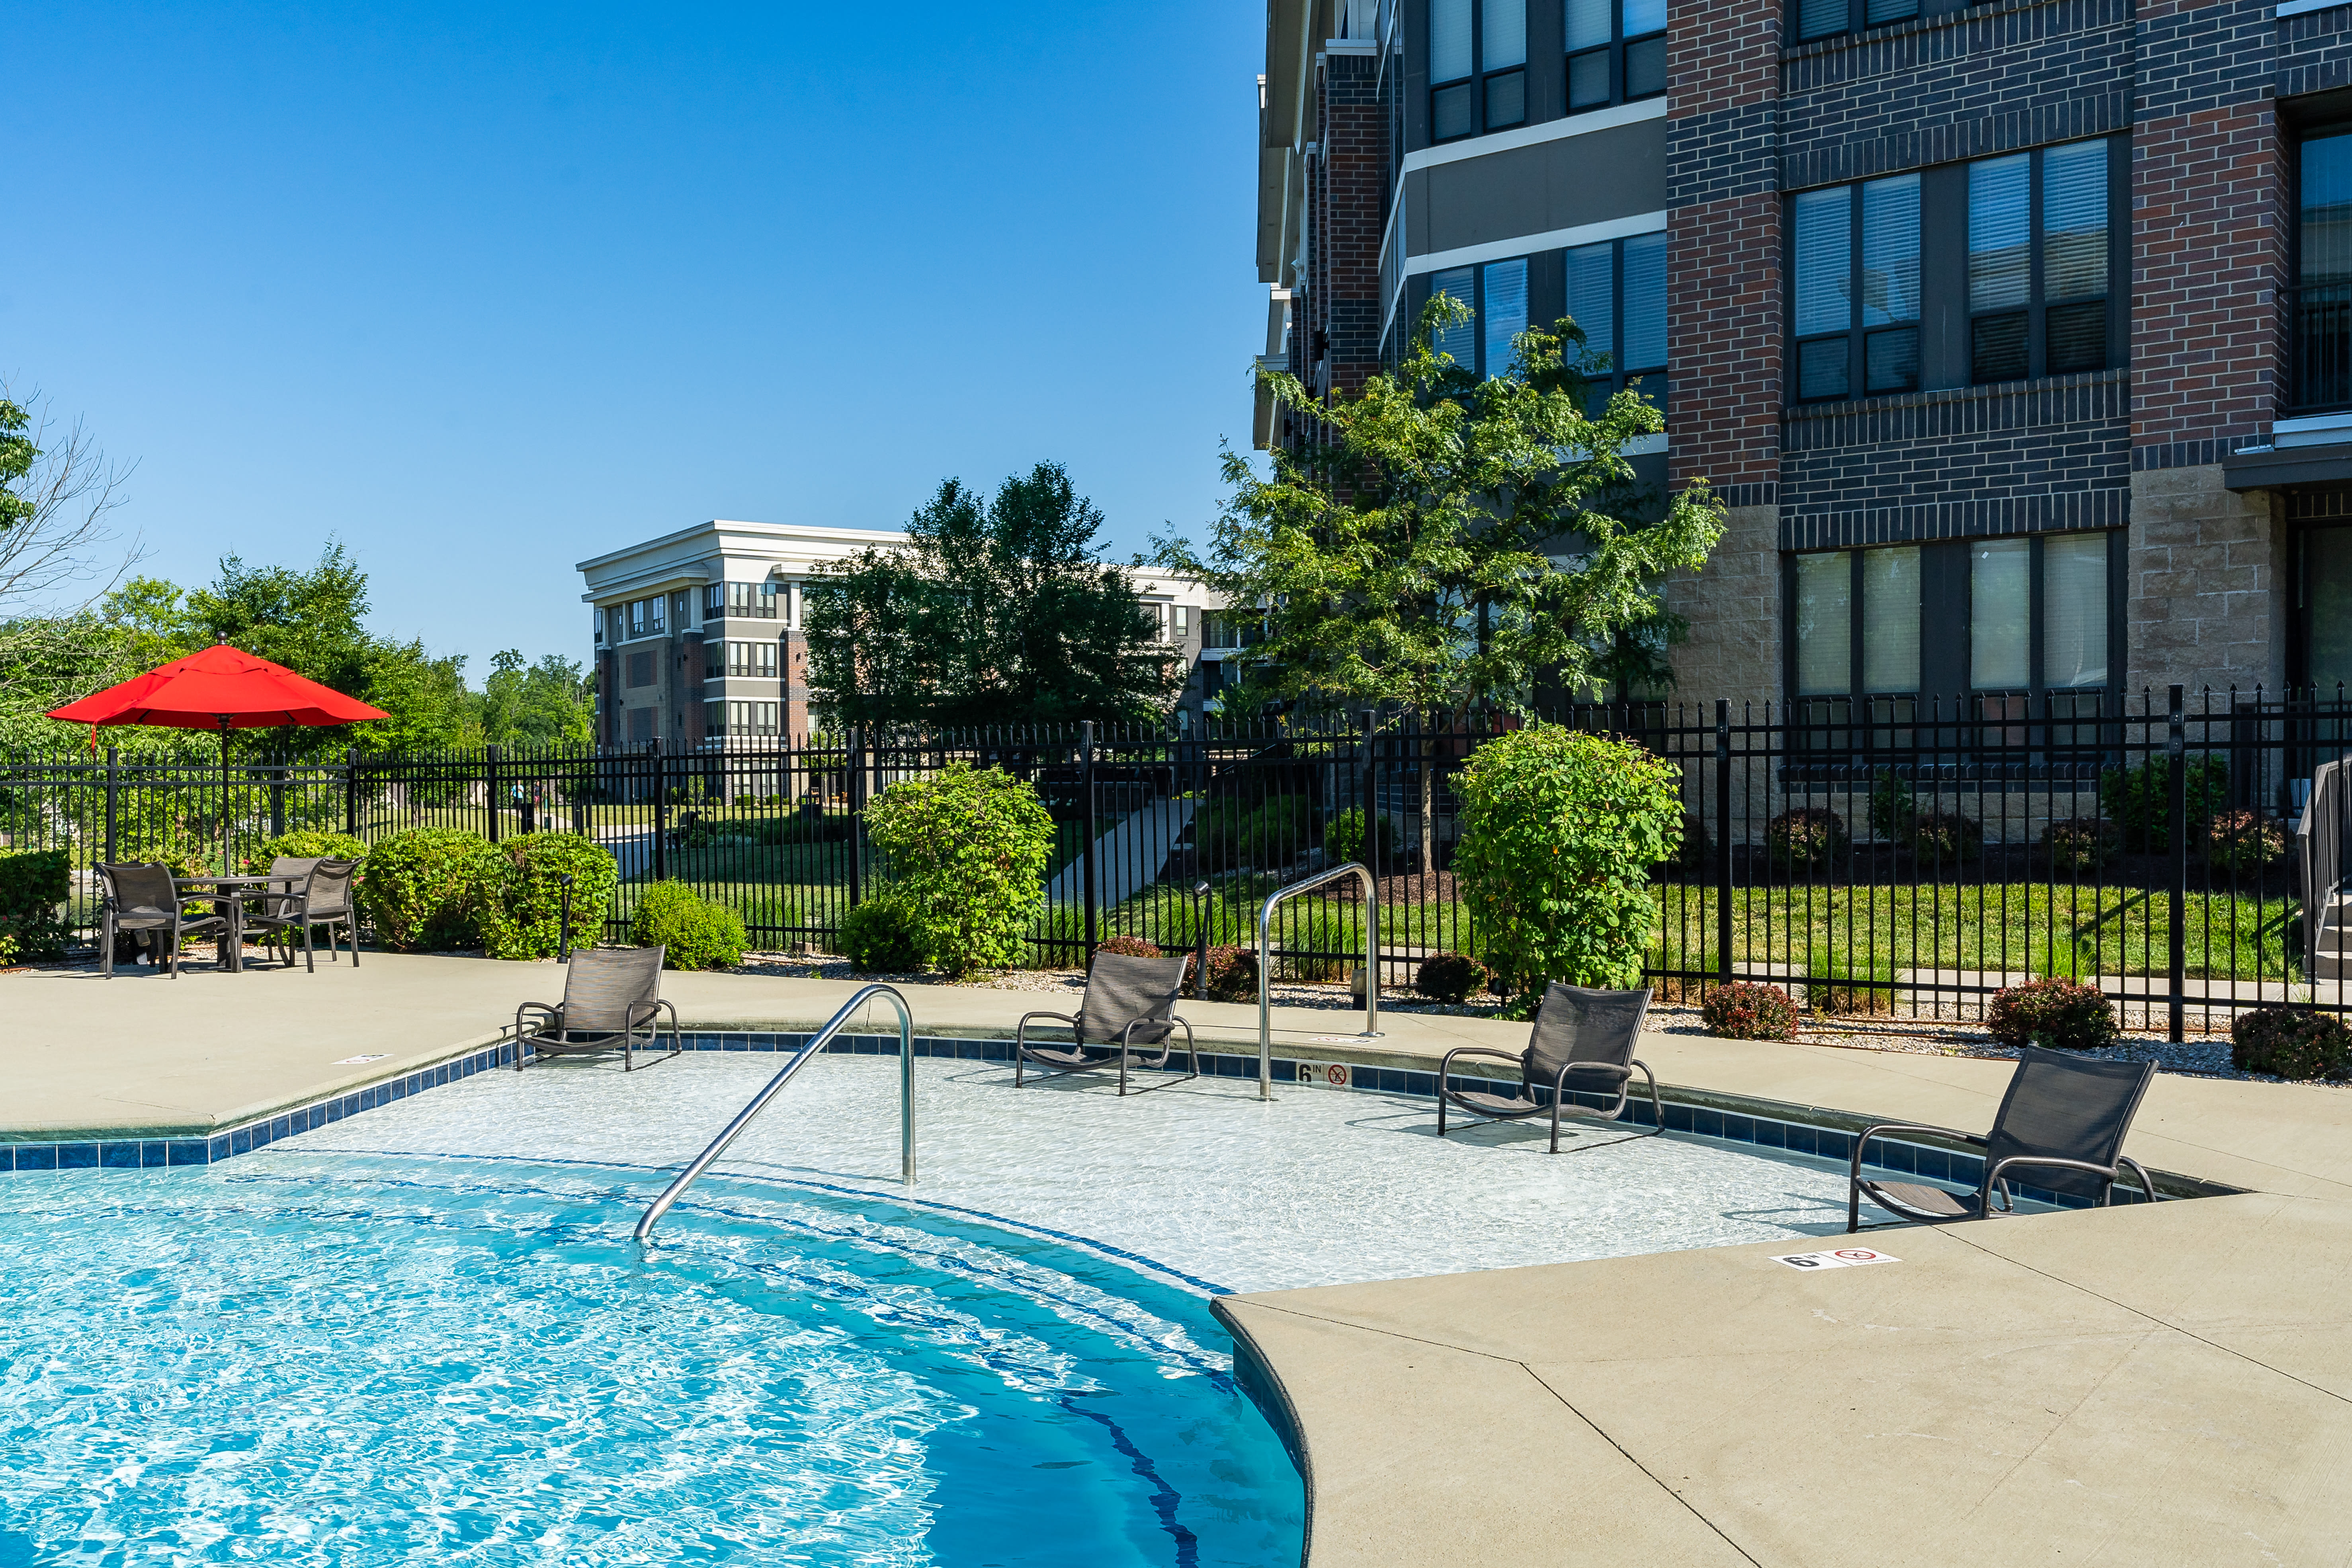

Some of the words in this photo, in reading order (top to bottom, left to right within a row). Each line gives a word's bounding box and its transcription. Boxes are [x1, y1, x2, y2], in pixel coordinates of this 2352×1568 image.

[1299, 1064, 1311, 1082] 6
[1313, 1064, 1321, 1073] IN
[1783, 1257, 1819, 1267] 6
